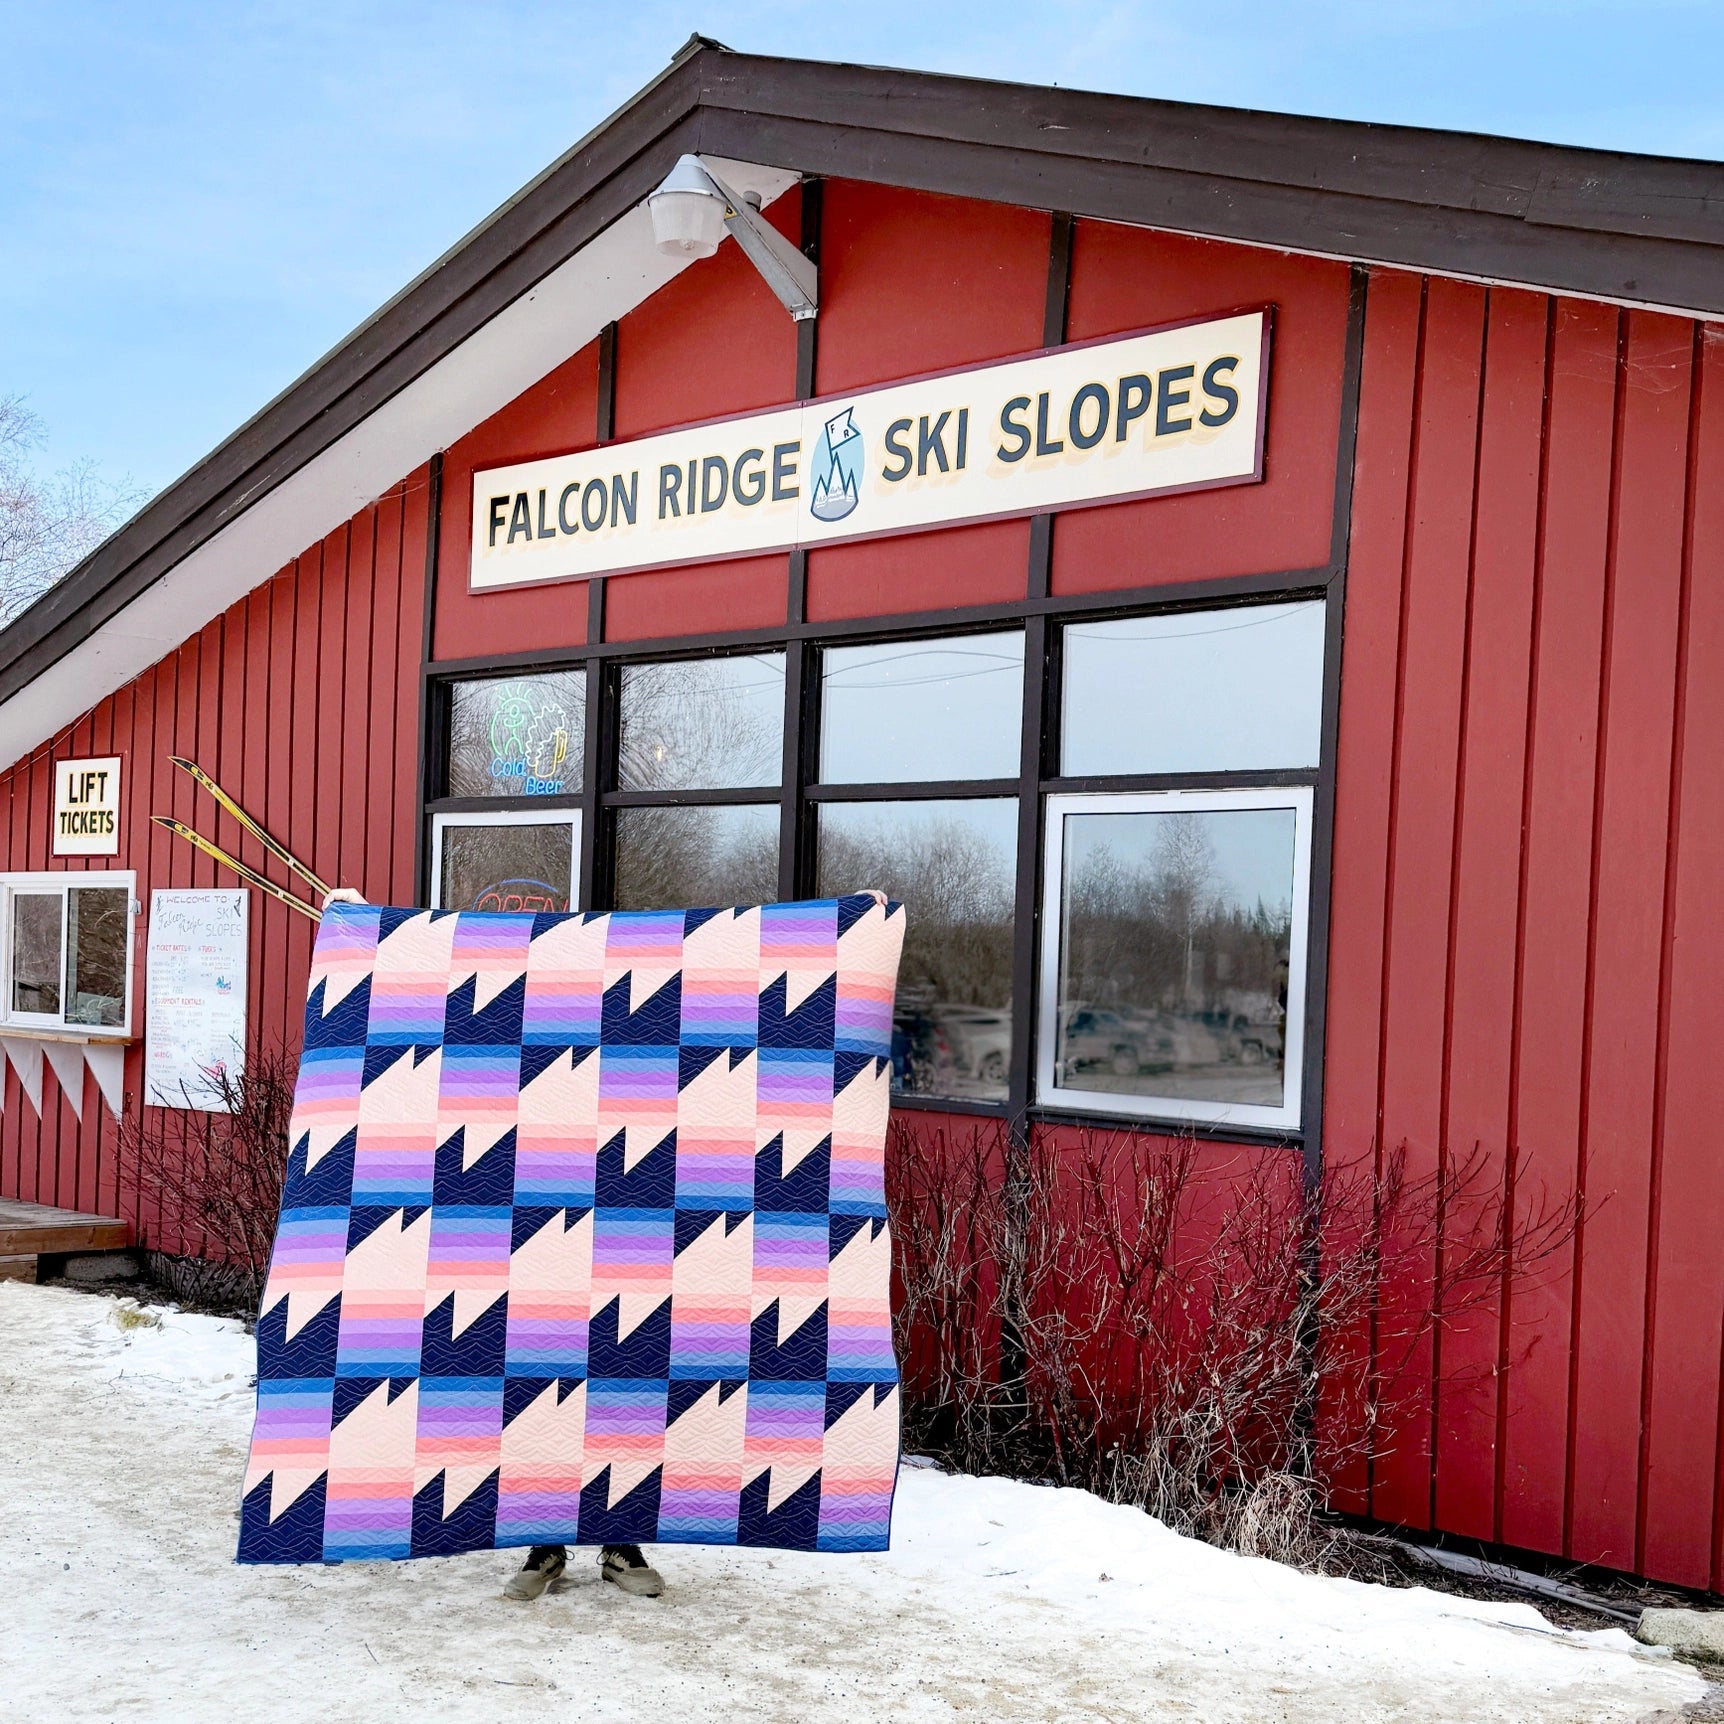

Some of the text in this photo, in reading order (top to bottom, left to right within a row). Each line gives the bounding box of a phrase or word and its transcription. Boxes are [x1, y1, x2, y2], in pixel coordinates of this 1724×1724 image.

[489, 356, 1240, 547] FALCON RIDGE SKI SLOPES
[491, 757, 527, 777] Cold
[68, 771, 108, 804] LIFT
[526, 776, 564, 795] Beer
[60, 810, 114, 834] TICKETS
[166, 895, 210, 904] WELCOME
[477, 893, 569, 912] OPEN
[216, 906, 234, 920] SKI
[206, 923, 242, 937] SLOPES
